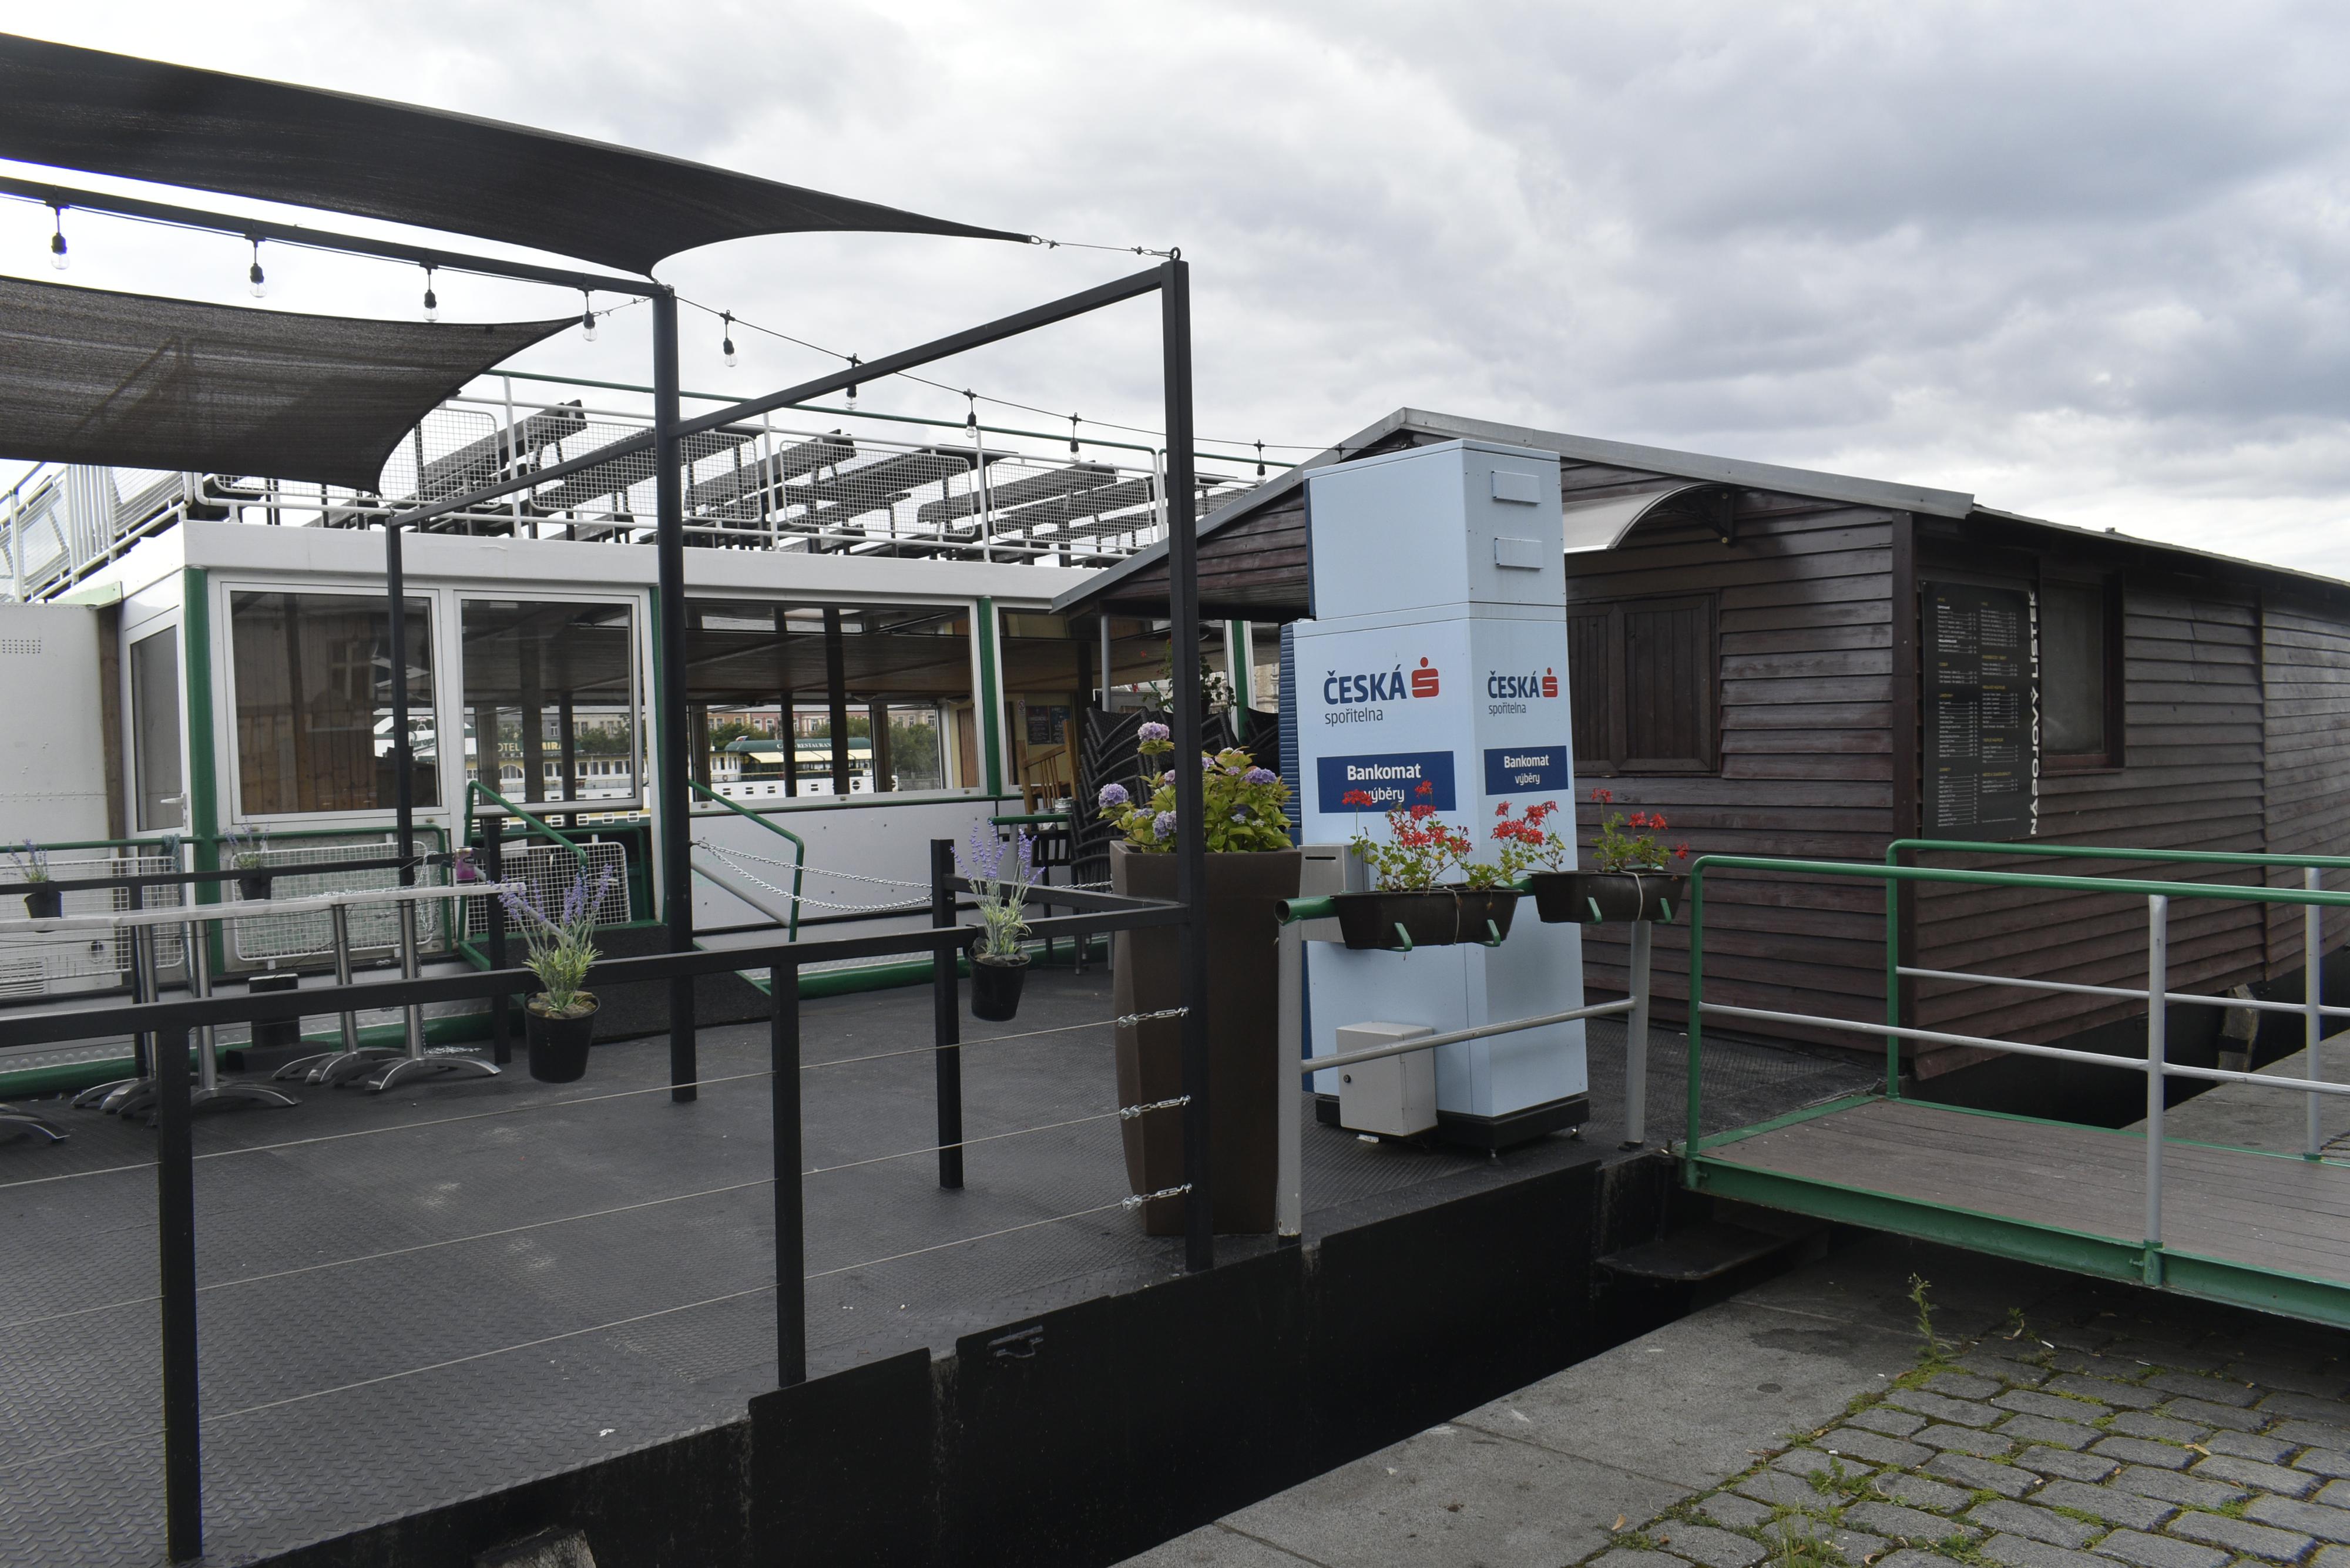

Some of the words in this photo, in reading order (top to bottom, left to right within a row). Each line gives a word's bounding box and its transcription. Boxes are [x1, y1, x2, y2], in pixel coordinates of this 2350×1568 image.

[2028, 590, 2039, 678] LÍSTEK
[1324, 664, 1408, 705] ČESKÁ
[1488, 670, 1540, 699] ČESKÁ
[1325, 707, 1384, 727] spořitelna
[1488, 702, 1527, 717] spořitelna
[498, 743, 521, 752] OTEL
[1504, 754, 1550, 768] Bankomat
[2030, 686, 2039, 835] NÁPOJOVÝ
[1347, 763, 1422, 781] Bankomat
[1515, 773, 1540, 786] výběry
